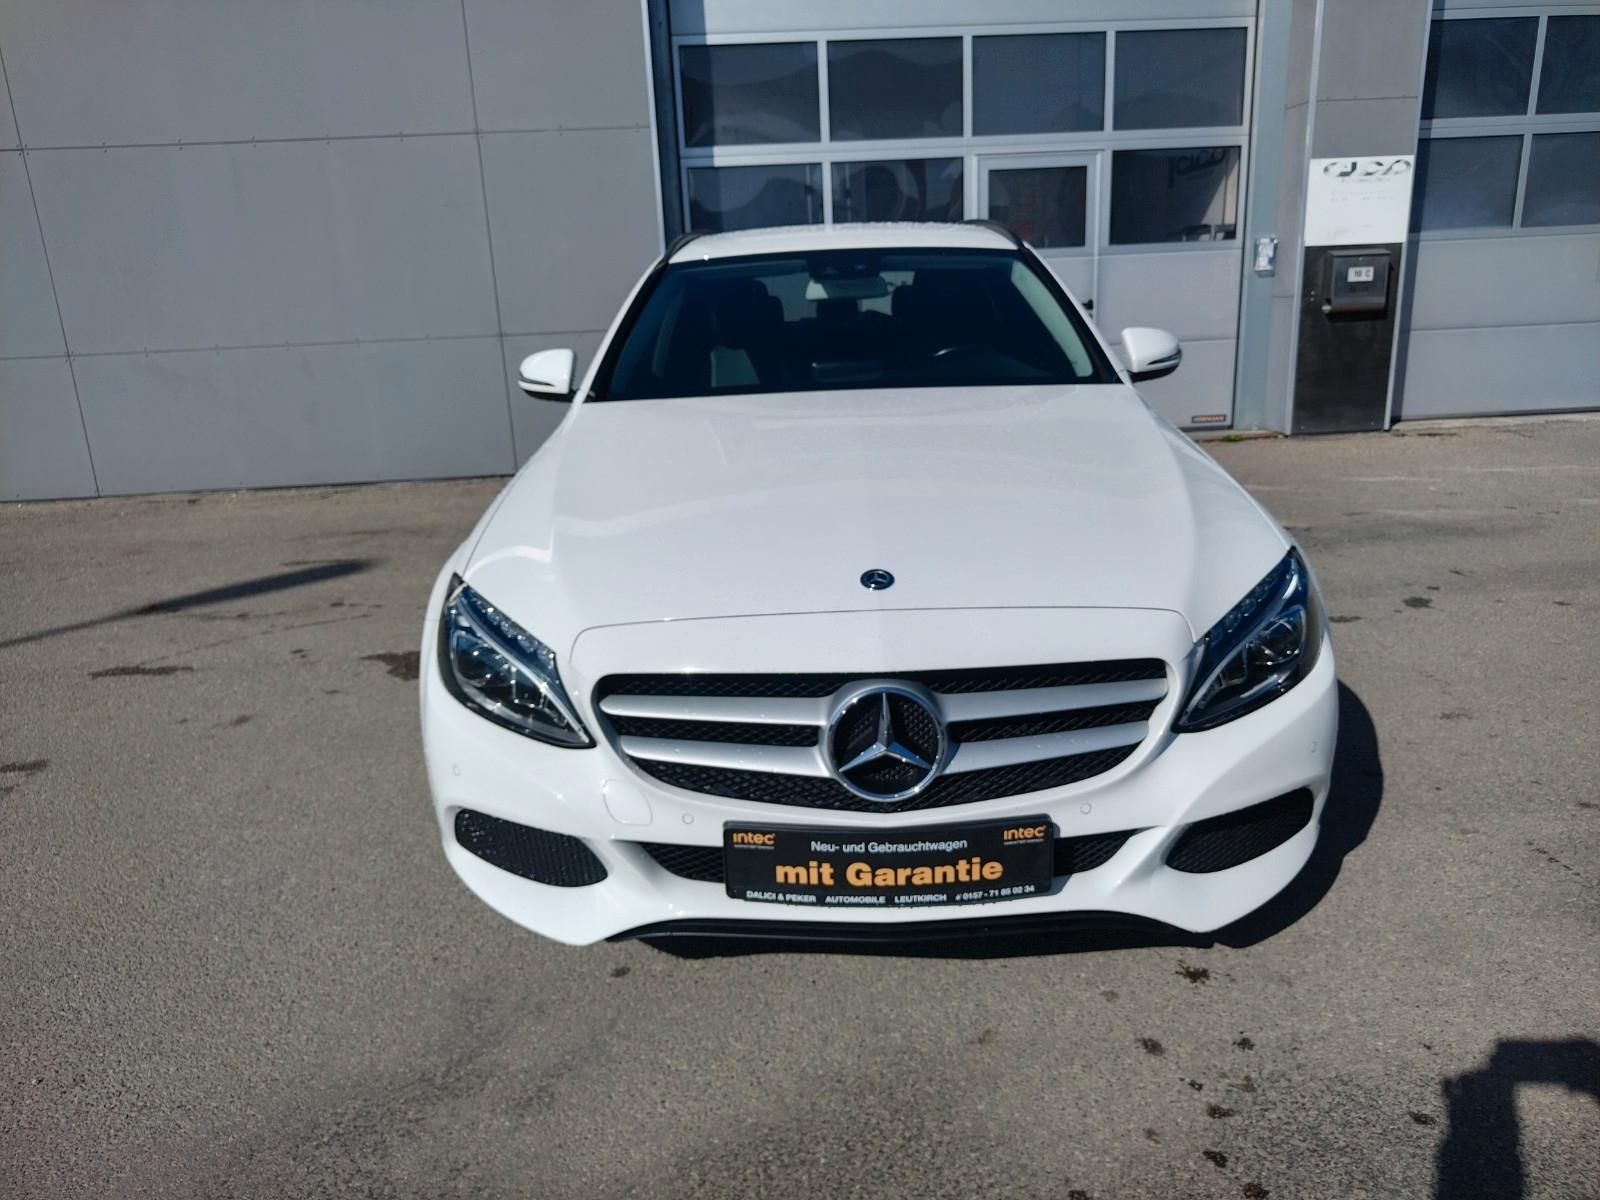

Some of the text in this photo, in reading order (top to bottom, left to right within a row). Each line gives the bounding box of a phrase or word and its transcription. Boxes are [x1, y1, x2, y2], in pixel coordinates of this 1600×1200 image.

[732, 831, 776, 845] intec
[1003, 825, 1047, 841] intec
[810, 839, 968, 853] Neu- und Gebrauchtwagen
[775, 856, 1004, 887] mit Garantie
[824, 895, 886, 904] AUTOMOBILE
[894, 894, 947, 904] LEUTKIRCH
